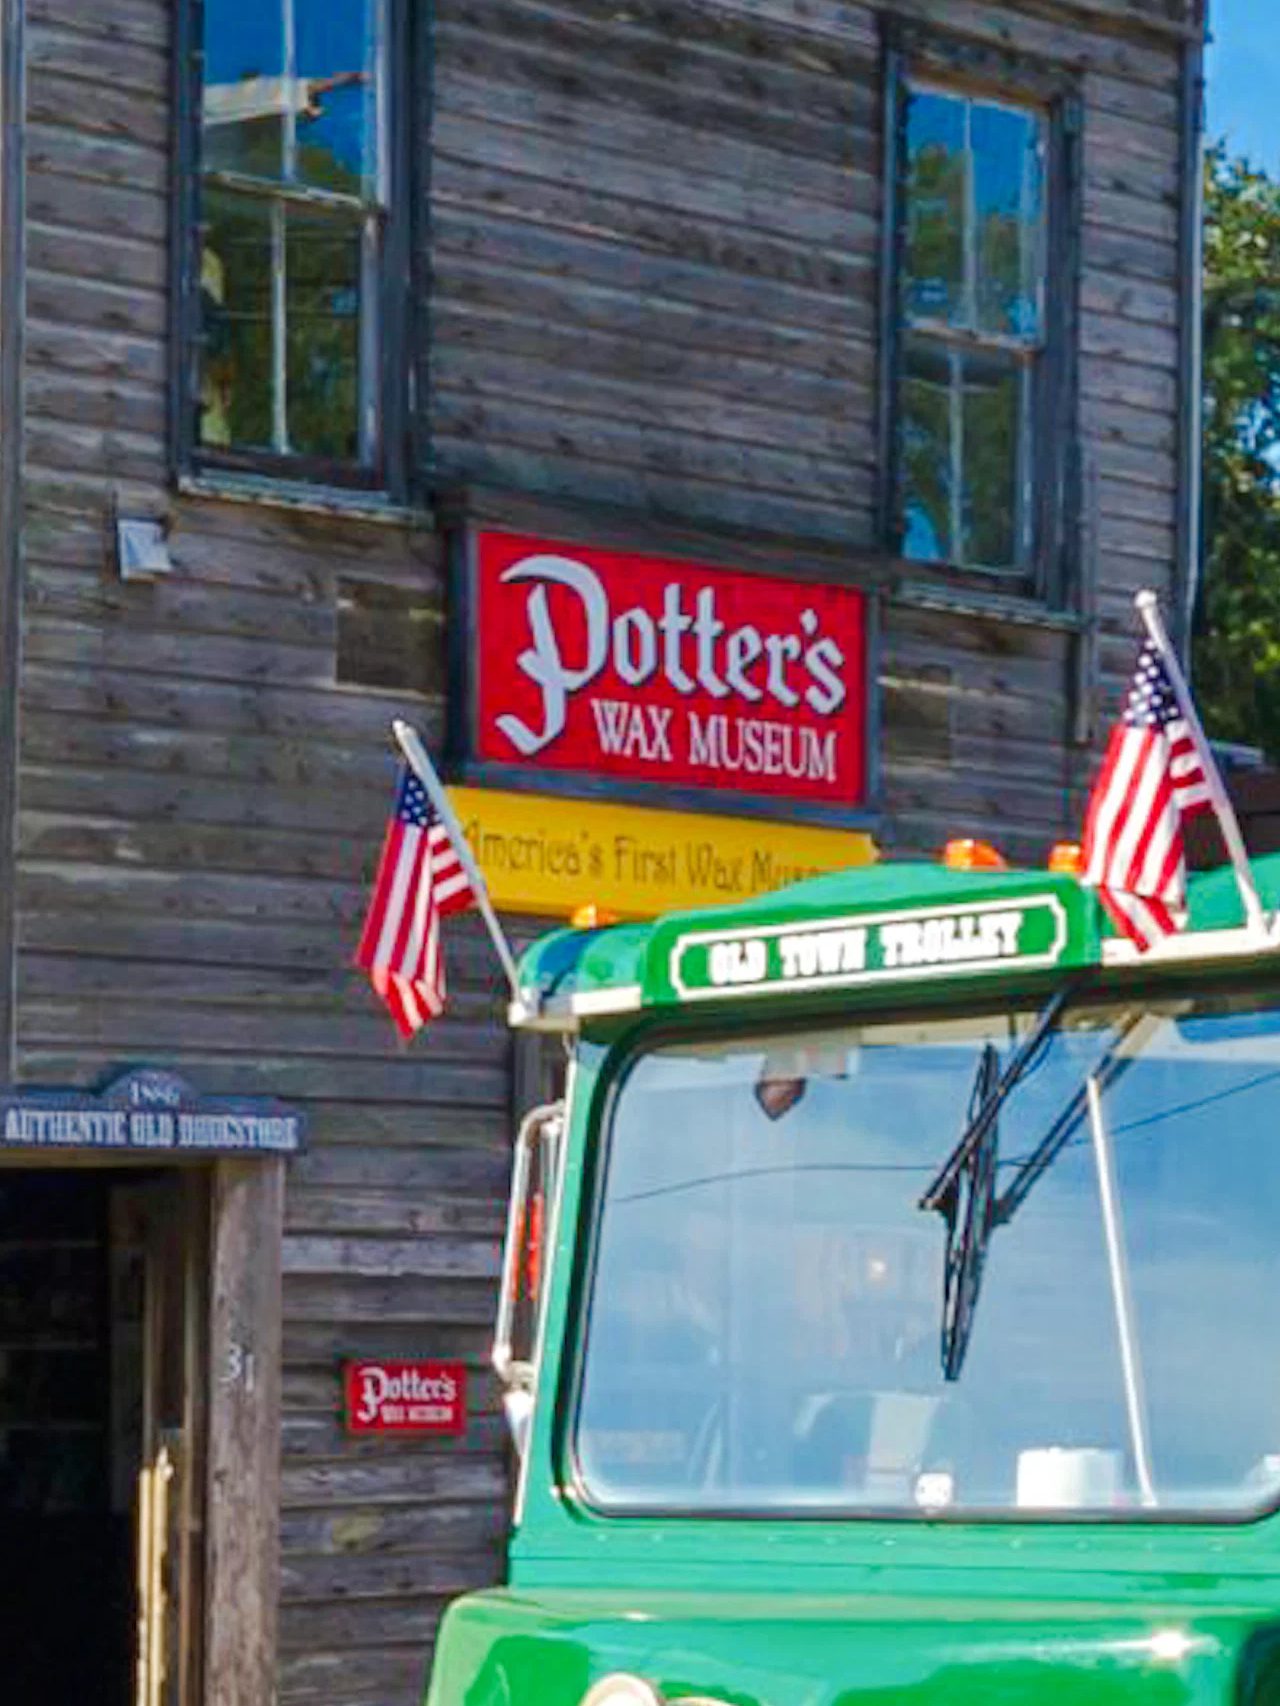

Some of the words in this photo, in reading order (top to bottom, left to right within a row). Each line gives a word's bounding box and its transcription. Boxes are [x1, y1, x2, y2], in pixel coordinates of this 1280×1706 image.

[495, 553, 847, 755] Potter's
[590, 698, 673, 763] WAX
[688, 711, 838, 782] MUSEUM
[613, 834, 677, 885] First
[686, 838, 742, 893] Wax
[707, 940, 767, 986] OLD
[778, 928, 867, 978] TOWN
[880, 912, 1023, 967] TROLLEY
[5, 1108, 128, 1143] AUTHENTIC
[130, 1111, 176, 1146] OLD
[178, 1113, 299, 1149] DRUGSTORE
[357, 1365, 457, 1424] Potter's
